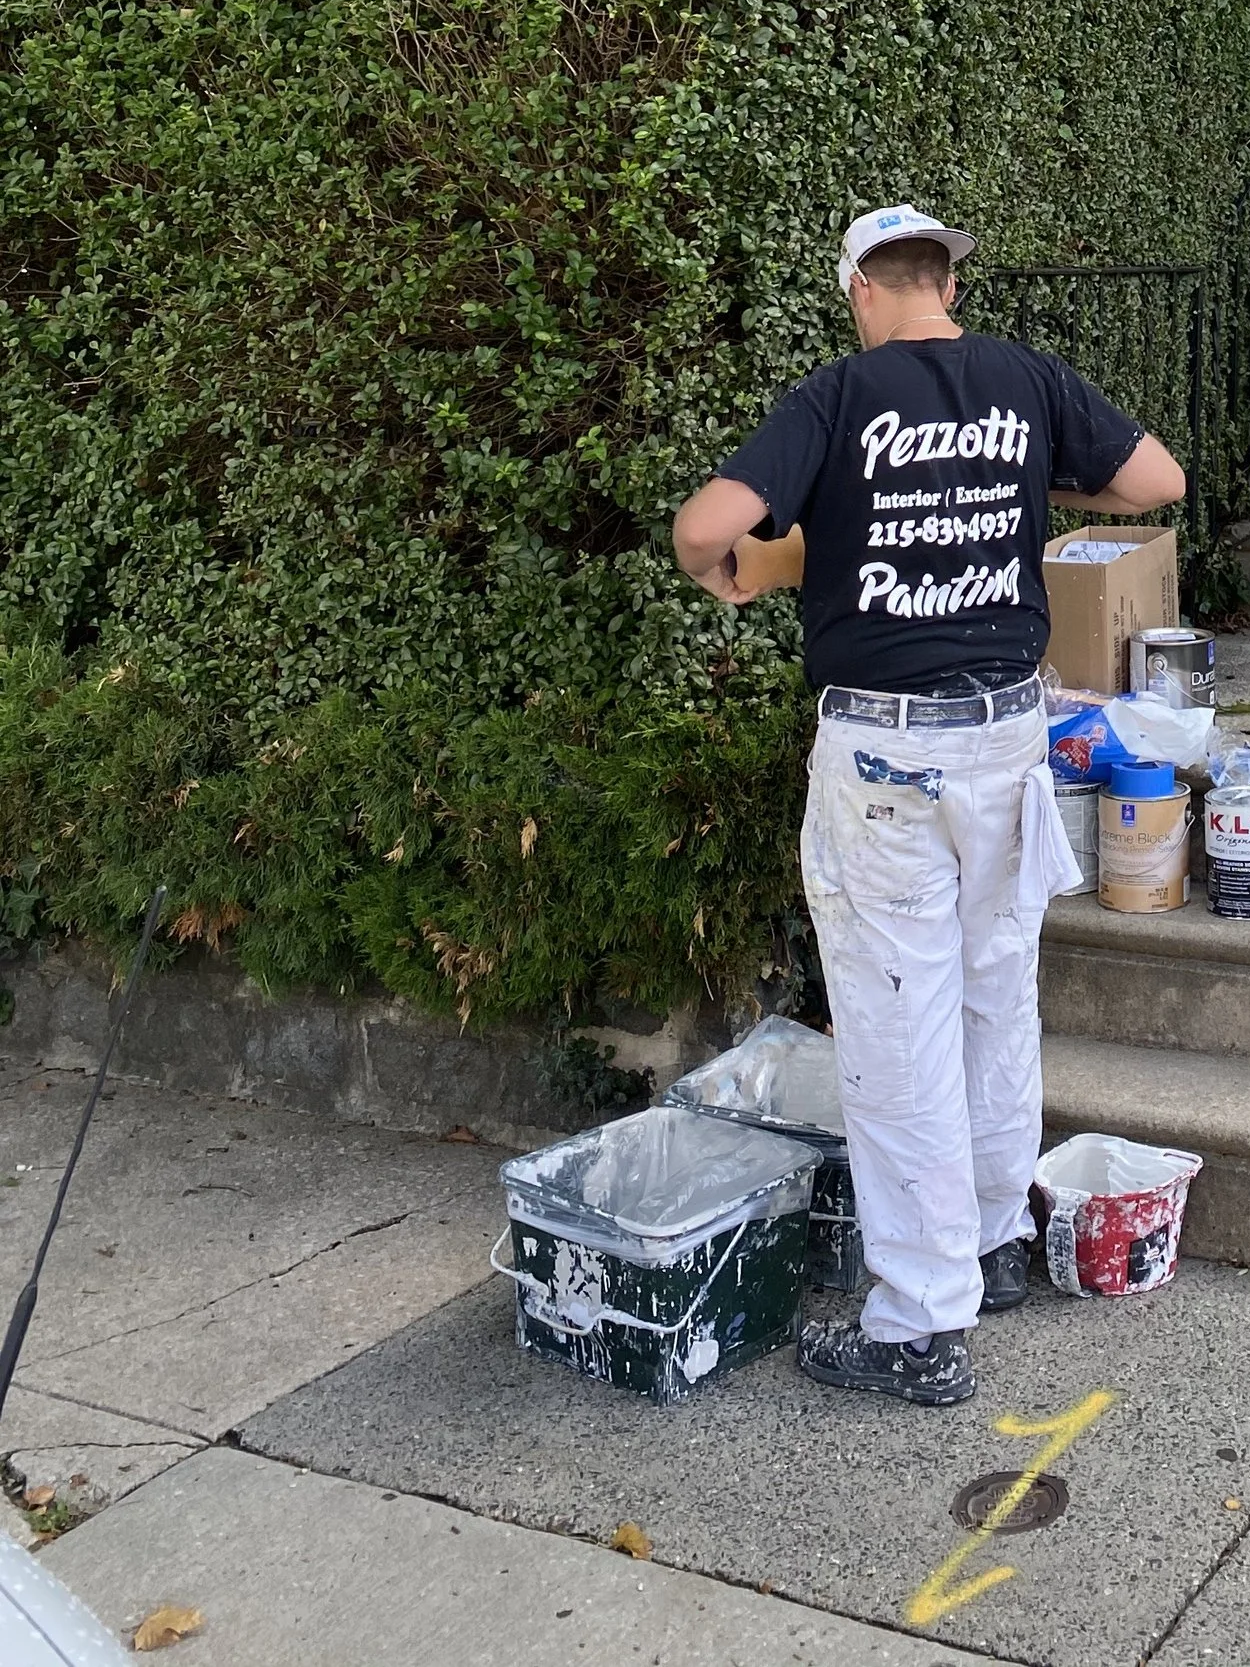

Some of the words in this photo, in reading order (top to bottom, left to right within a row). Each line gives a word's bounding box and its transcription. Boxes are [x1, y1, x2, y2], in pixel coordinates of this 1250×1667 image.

[861, 406, 1030, 480] Pezzotti
[872, 489, 942, 509] Interior
[955, 483, 1018, 504] Exterior
[858, 556, 1021, 619] Painting
[1137, 832, 1172, 845] Block
